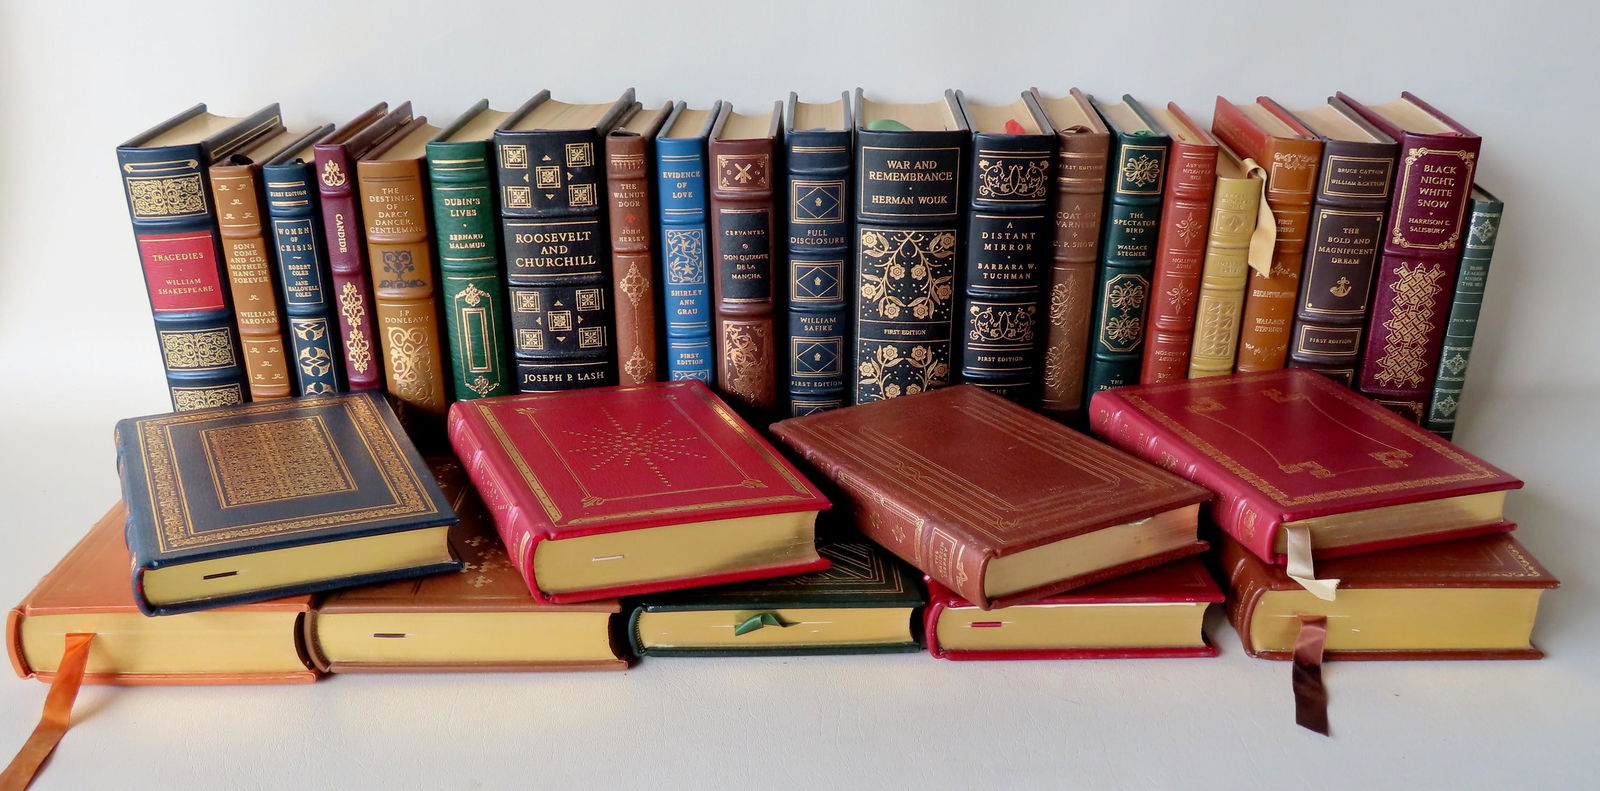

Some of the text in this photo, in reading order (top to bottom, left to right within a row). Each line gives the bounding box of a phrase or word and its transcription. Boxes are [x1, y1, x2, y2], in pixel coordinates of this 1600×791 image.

[887, 160, 937, 170] WAR AND
[1423, 164, 1457, 174] BLACK
[869, 171, 953, 181] REMEMBRANCE
[1420, 176, 1455, 186] NIGHT,
[1419, 188, 1452, 197] WHITE
[369, 194, 415, 202] DESTINIES
[444, 198, 480, 206] DUBIN'S
[872, 195, 948, 205] HERMAN WOUK
[1418, 199, 1449, 208] SNOW
[335, 214, 347, 253] CANDIDE
[516, 232, 591, 243] ROOSEVELT
[982, 232, 1036, 240] DISTANT
[280, 243, 312, 252] CRISIS
[541, 246, 568, 254] AND
[984, 243, 1032, 251] MIRROR
[1318, 246, 1374, 254] MAGNIFICENT
[152, 252, 204, 262] TRAGEDIES
[515, 256, 596, 267] CHURCHILL
[158, 286, 214, 295] SHAKESPEARE
[524, 374, 563, 383] JOSEPH
[578, 372, 605, 381] LASH
